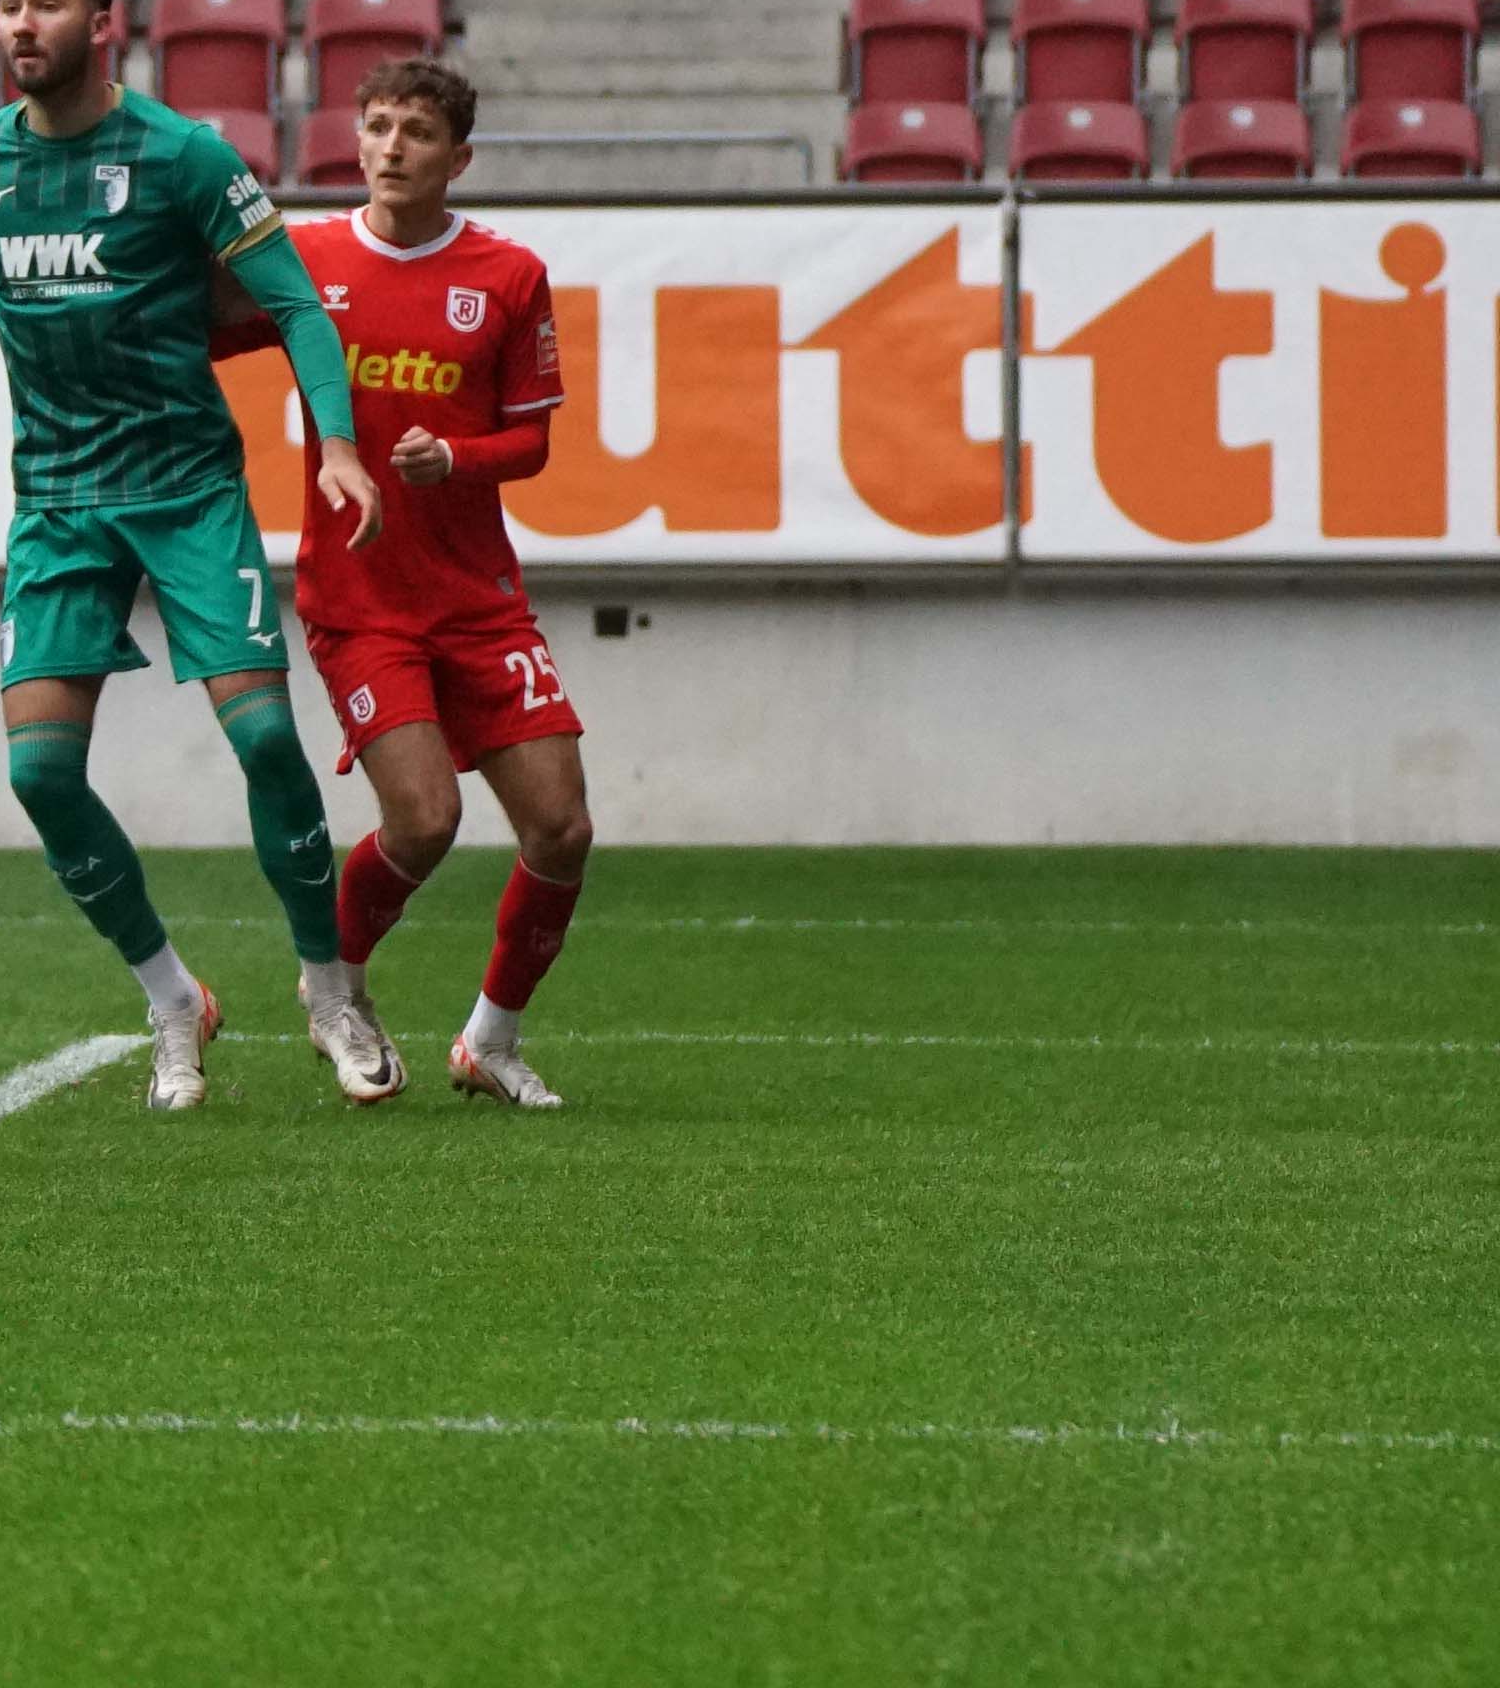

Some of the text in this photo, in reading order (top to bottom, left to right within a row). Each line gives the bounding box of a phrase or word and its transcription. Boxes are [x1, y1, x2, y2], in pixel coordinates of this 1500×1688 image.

[0, 233, 108, 278] WWK
[213, 222, 1500, 543] utti
[238, 568, 263, 628] 7
[504, 645, 567, 711] 25
